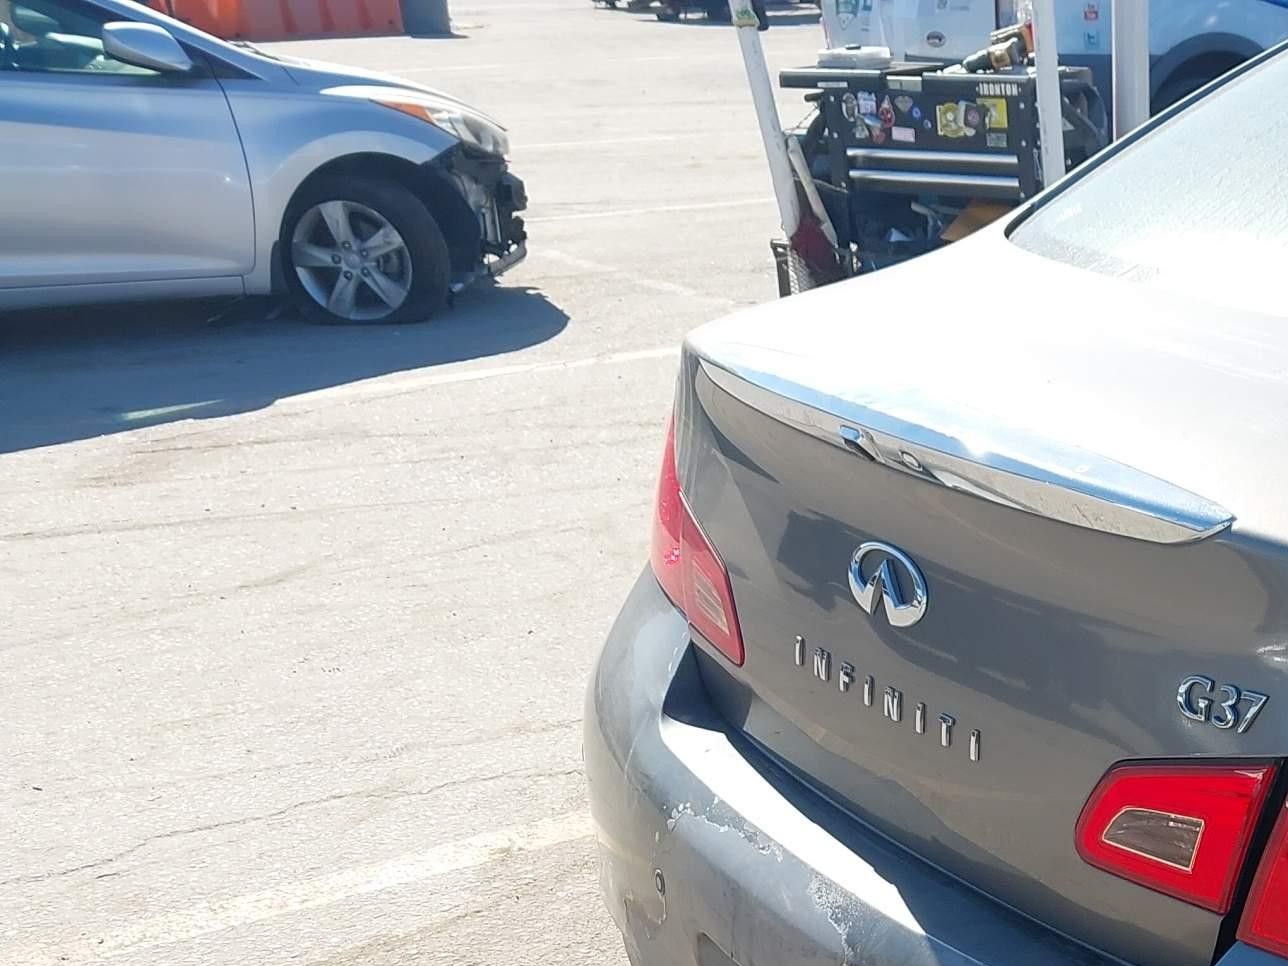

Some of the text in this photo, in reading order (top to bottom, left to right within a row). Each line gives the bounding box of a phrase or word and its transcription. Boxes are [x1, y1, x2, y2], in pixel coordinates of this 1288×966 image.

[978, 82, 1018, 96] IRONTON
[793, 635, 982, 762] INFINITI
[1176, 675, 1270, 735] G37
